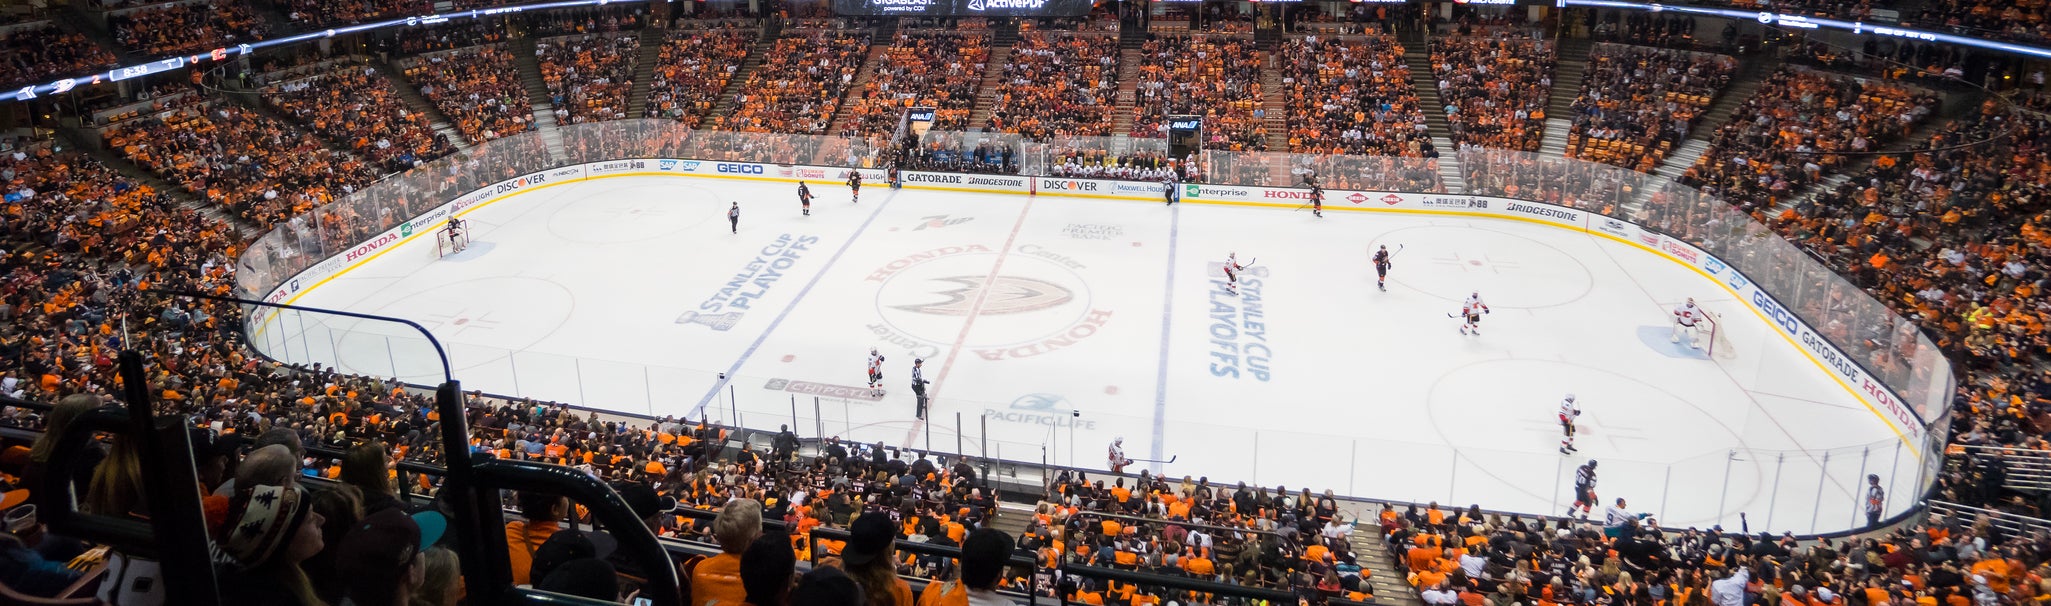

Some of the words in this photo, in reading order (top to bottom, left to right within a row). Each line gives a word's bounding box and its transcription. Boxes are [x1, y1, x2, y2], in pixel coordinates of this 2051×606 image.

[91, 74, 101, 84] 2
[123, 64, 148, 77] 8:38
[1172, 121, 1189, 129] ANA
[717, 163, 763, 174] GEICO
[908, 173, 962, 184] GATORADE
[968, 177, 1023, 187] BRIDGESTONE
[475, 190, 494, 202] LIGHT
[1506, 202, 1577, 221] BRIDGESTONE
[346, 231, 398, 263] HONDA
[700, 256, 768, 313] STANLEY
[760, 233, 793, 257] CUP
[728, 235, 820, 310] PLAYOFFS
[864, 244, 993, 284] HONDA
[1017, 244, 1087, 271] Center
[1238, 275, 1267, 342] STANLEY
[1753, 290, 1798, 336] GEICO
[866, 323, 941, 359] Center
[972, 309, 1115, 361] HONDA
[1243, 342, 1273, 383] CUP
[1802, 332, 1859, 383] GATORADE
[791, 382, 873, 399] CHIPOTL
[984, 408, 1052, 426] PACIFIC
[1055, 415, 1097, 430] LIFE
[1862, 377, 1918, 438] HONDA
[1606, 512, 1614, 526] 9
